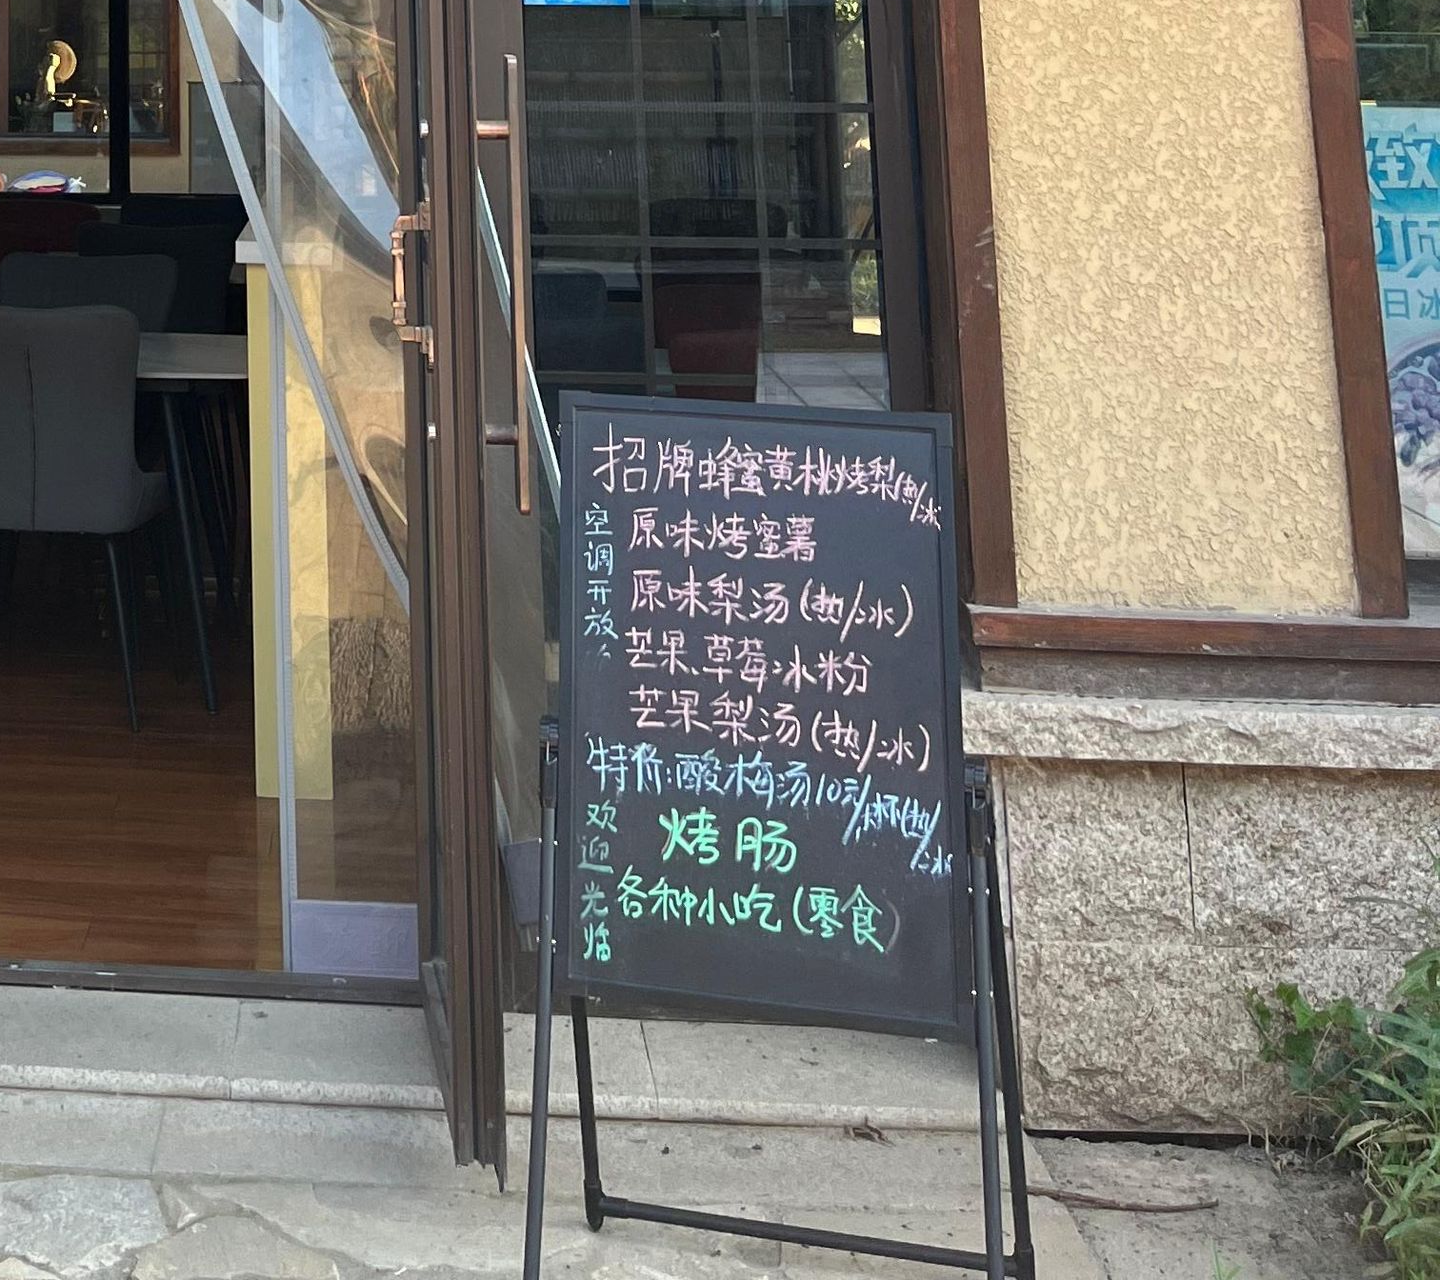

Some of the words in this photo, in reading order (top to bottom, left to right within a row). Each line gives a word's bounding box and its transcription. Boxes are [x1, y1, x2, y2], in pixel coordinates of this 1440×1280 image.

[627, 506, 818, 562] 原味烤蜜薯
[659, 806, 798, 873] 烤肠
